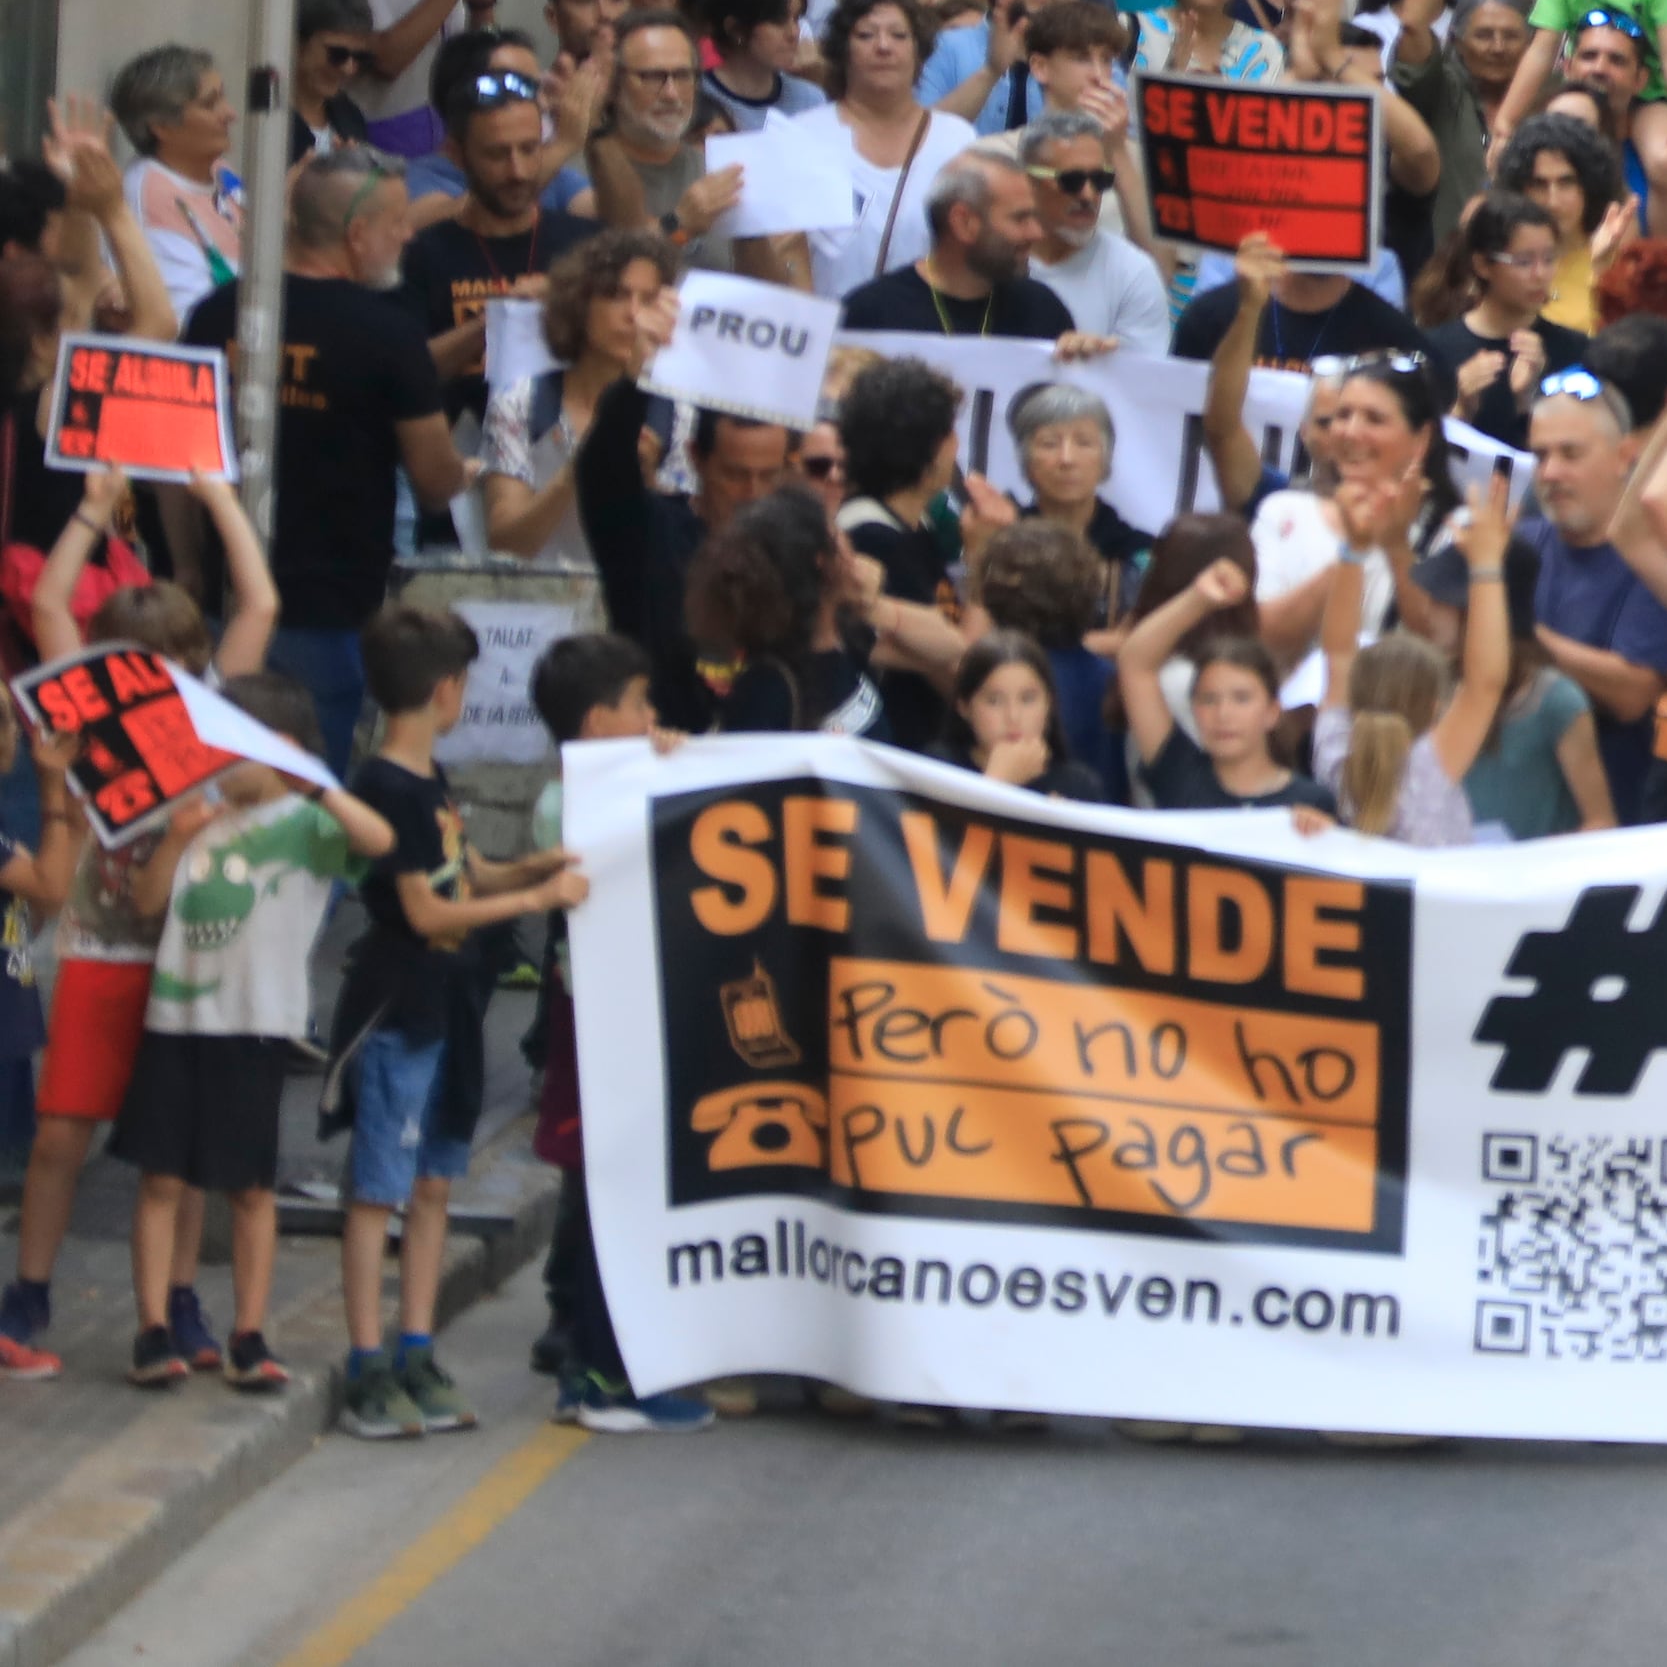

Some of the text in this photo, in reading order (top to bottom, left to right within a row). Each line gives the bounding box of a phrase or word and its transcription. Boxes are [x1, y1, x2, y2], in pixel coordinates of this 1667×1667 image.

[1143, 84, 1367, 155] SE VENDE
[69, 348, 111, 394] SE
[690, 305, 810, 358] PROU
[37, 664, 112, 733] SE
[690, 796, 1367, 1001] SE VENDE
[834, 980, 1357, 1105] Però no ho
[840, 1104, 1329, 1216] puc pagar
[665, 1219, 1401, 1339] mallorcanoesven.com
